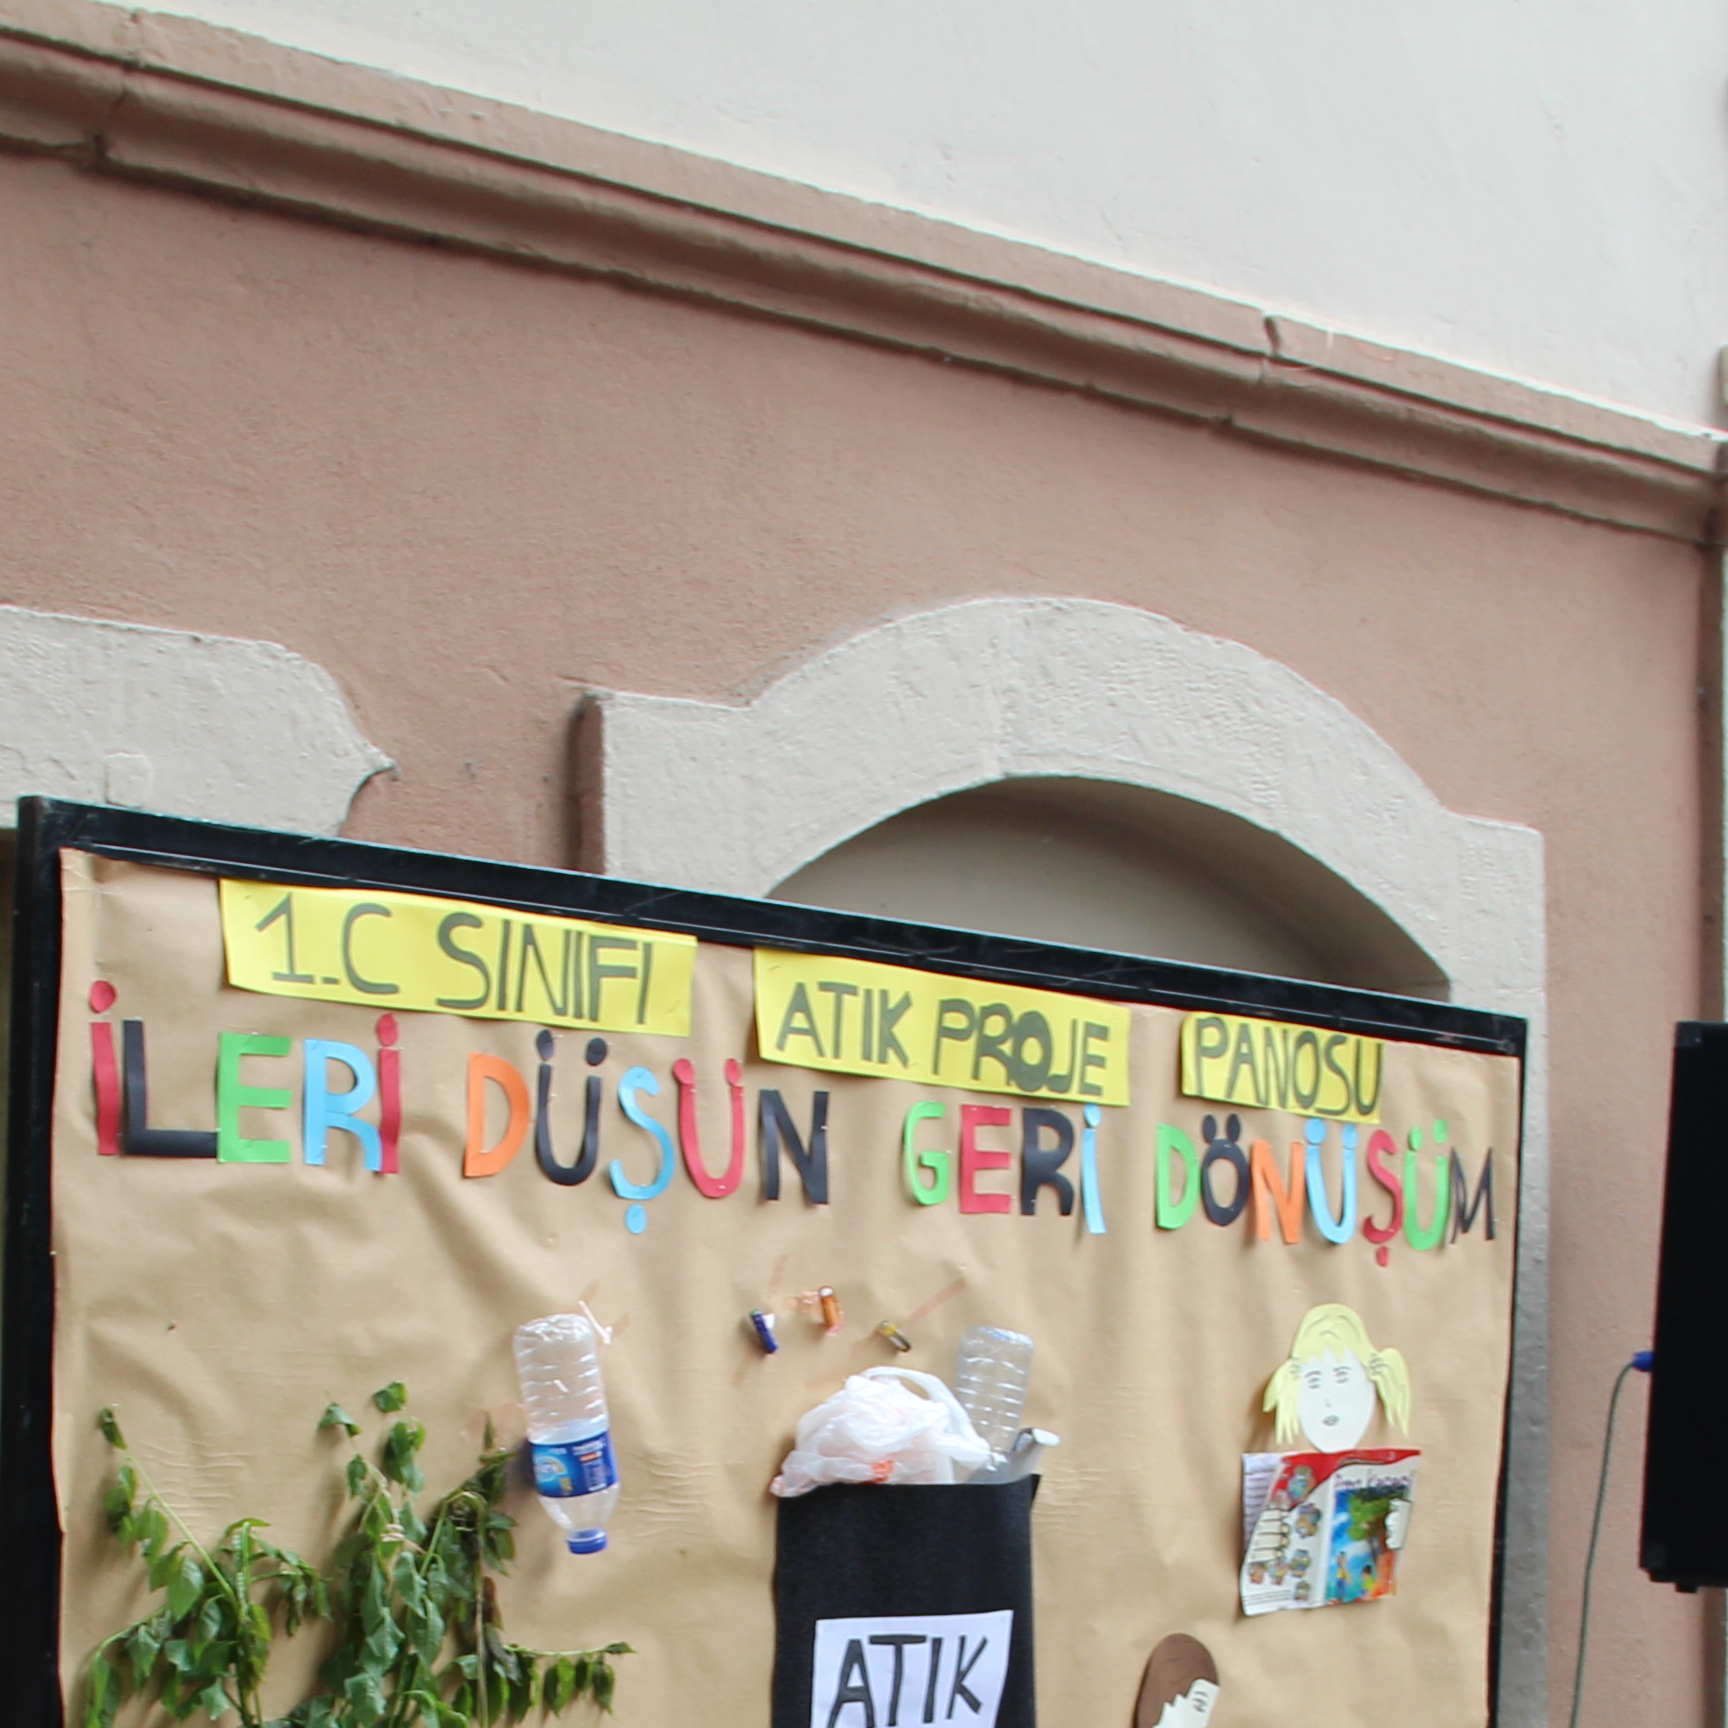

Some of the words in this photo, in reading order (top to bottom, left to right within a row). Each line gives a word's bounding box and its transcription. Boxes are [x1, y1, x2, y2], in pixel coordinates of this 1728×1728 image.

[434, 911, 654, 1026] SINIFI
[775, 980, 914, 1068] ATIK
[932, 997, 1110, 1099] PROJE
[1190, 1014, 1385, 1118] PANOSU
[89, 980, 402, 1175] İLERİ
[462, 1029, 830, 1235] DÜŞÜN
[902, 1100, 1107, 1235] GERİ
[1156, 1112, 1497, 1268] DÖNÜŞÜM
